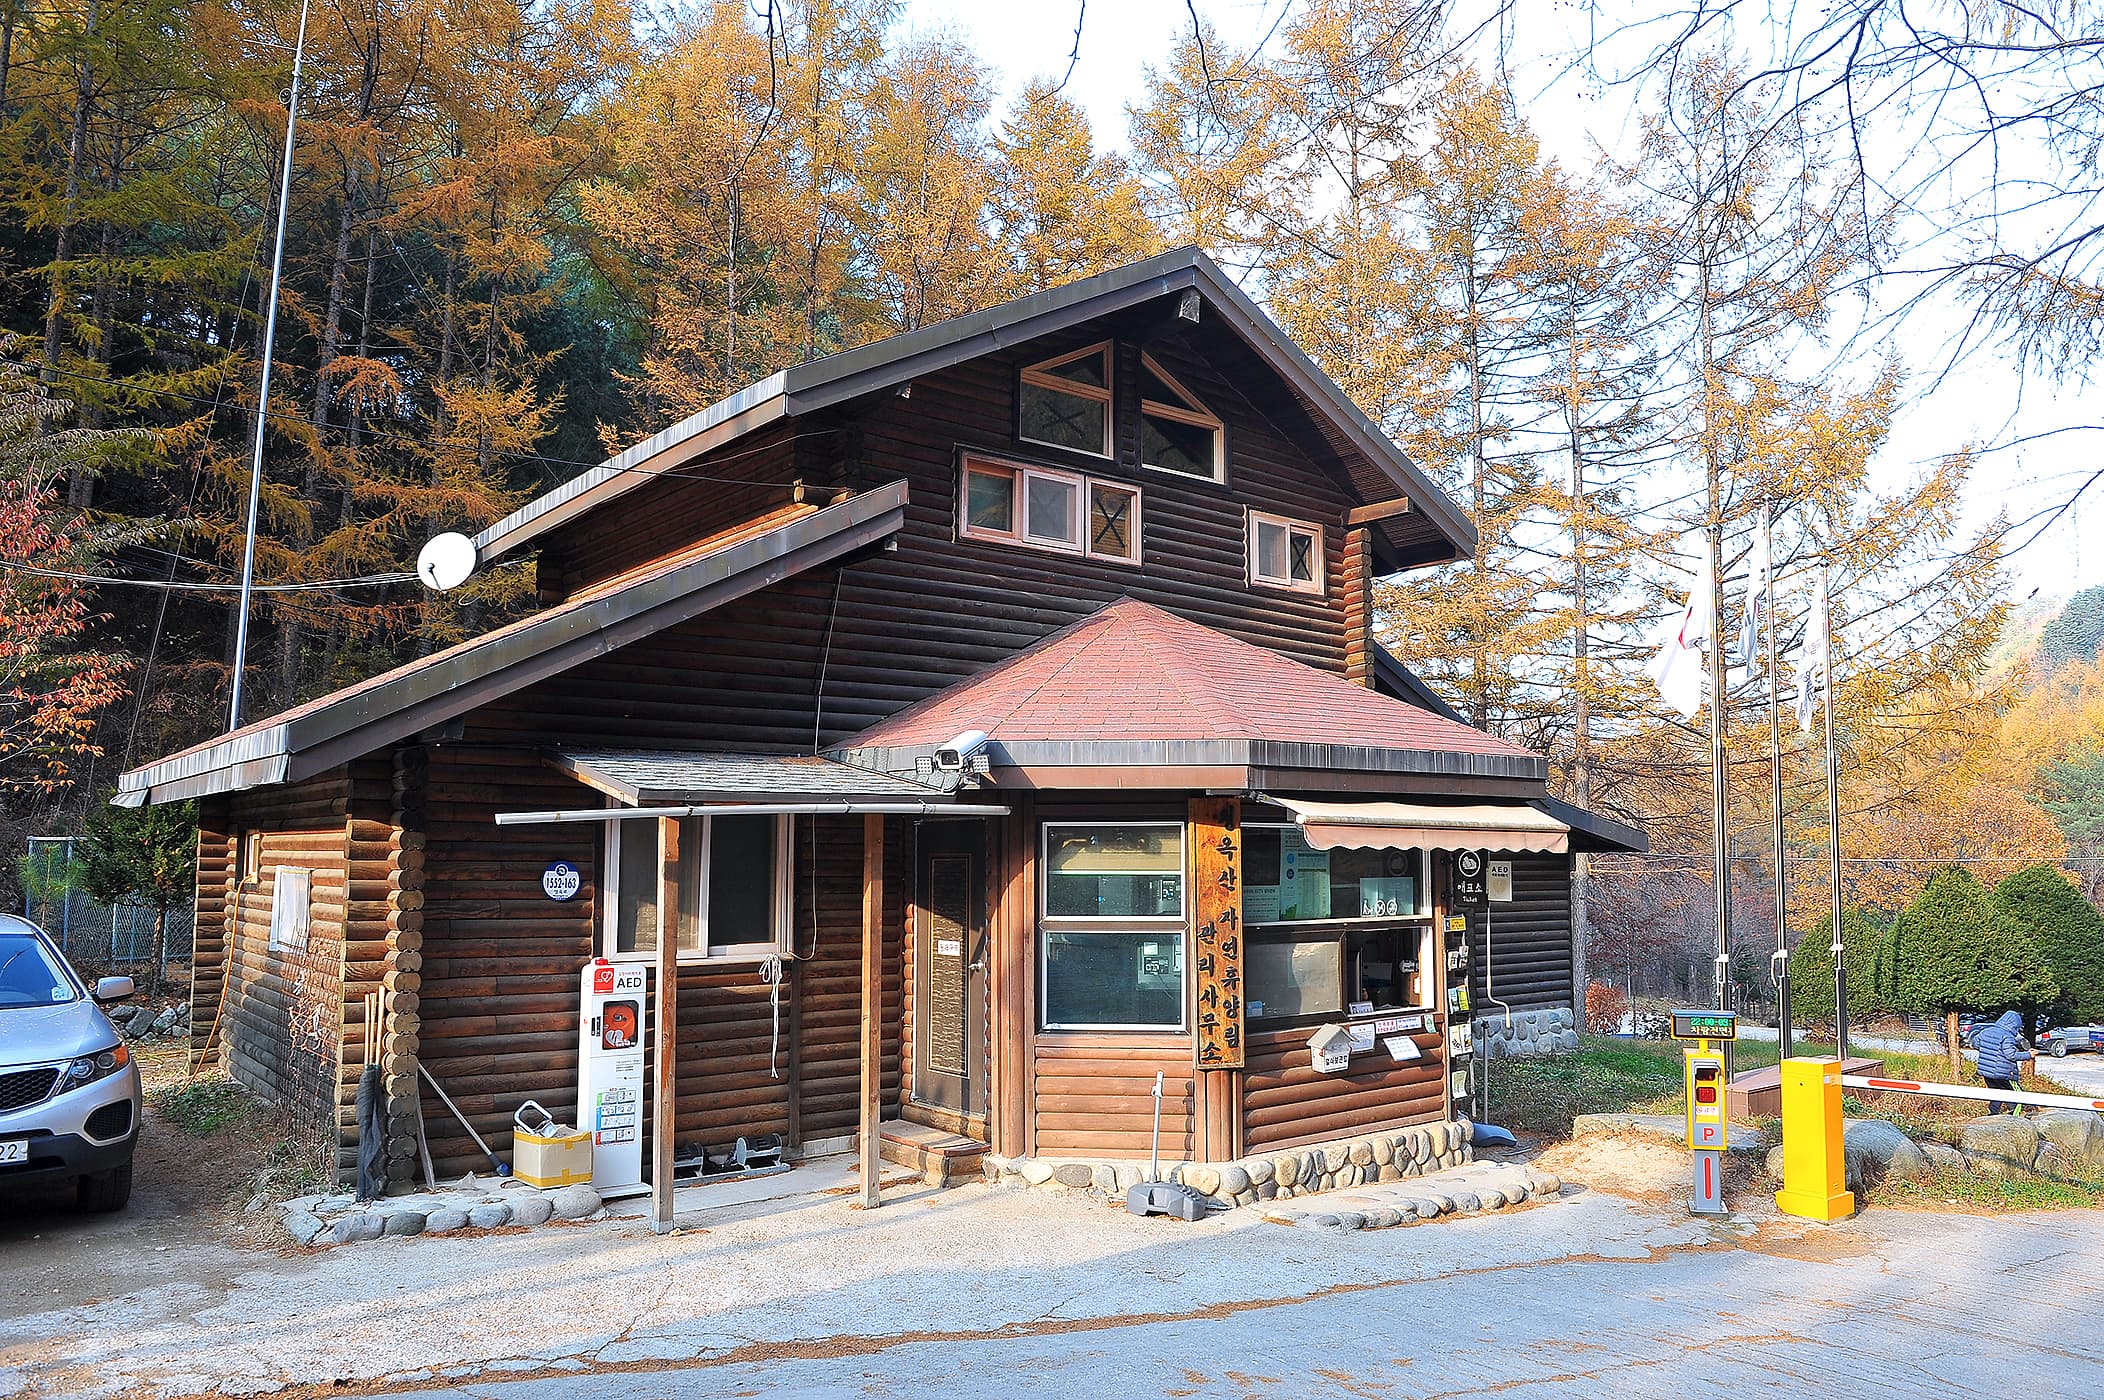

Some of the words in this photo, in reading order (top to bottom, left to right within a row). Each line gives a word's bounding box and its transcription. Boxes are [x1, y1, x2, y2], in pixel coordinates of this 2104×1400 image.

[546, 877, 577, 889] 1552-163
[1456, 880, 1483, 894] 매표소
[616, 977, 642, 988] AED
[1219, 905, 1240, 1048] 자연휴양림
[1197, 920, 1223, 1061] 관리사무소
[1703, 1127, 1715, 1141] P
